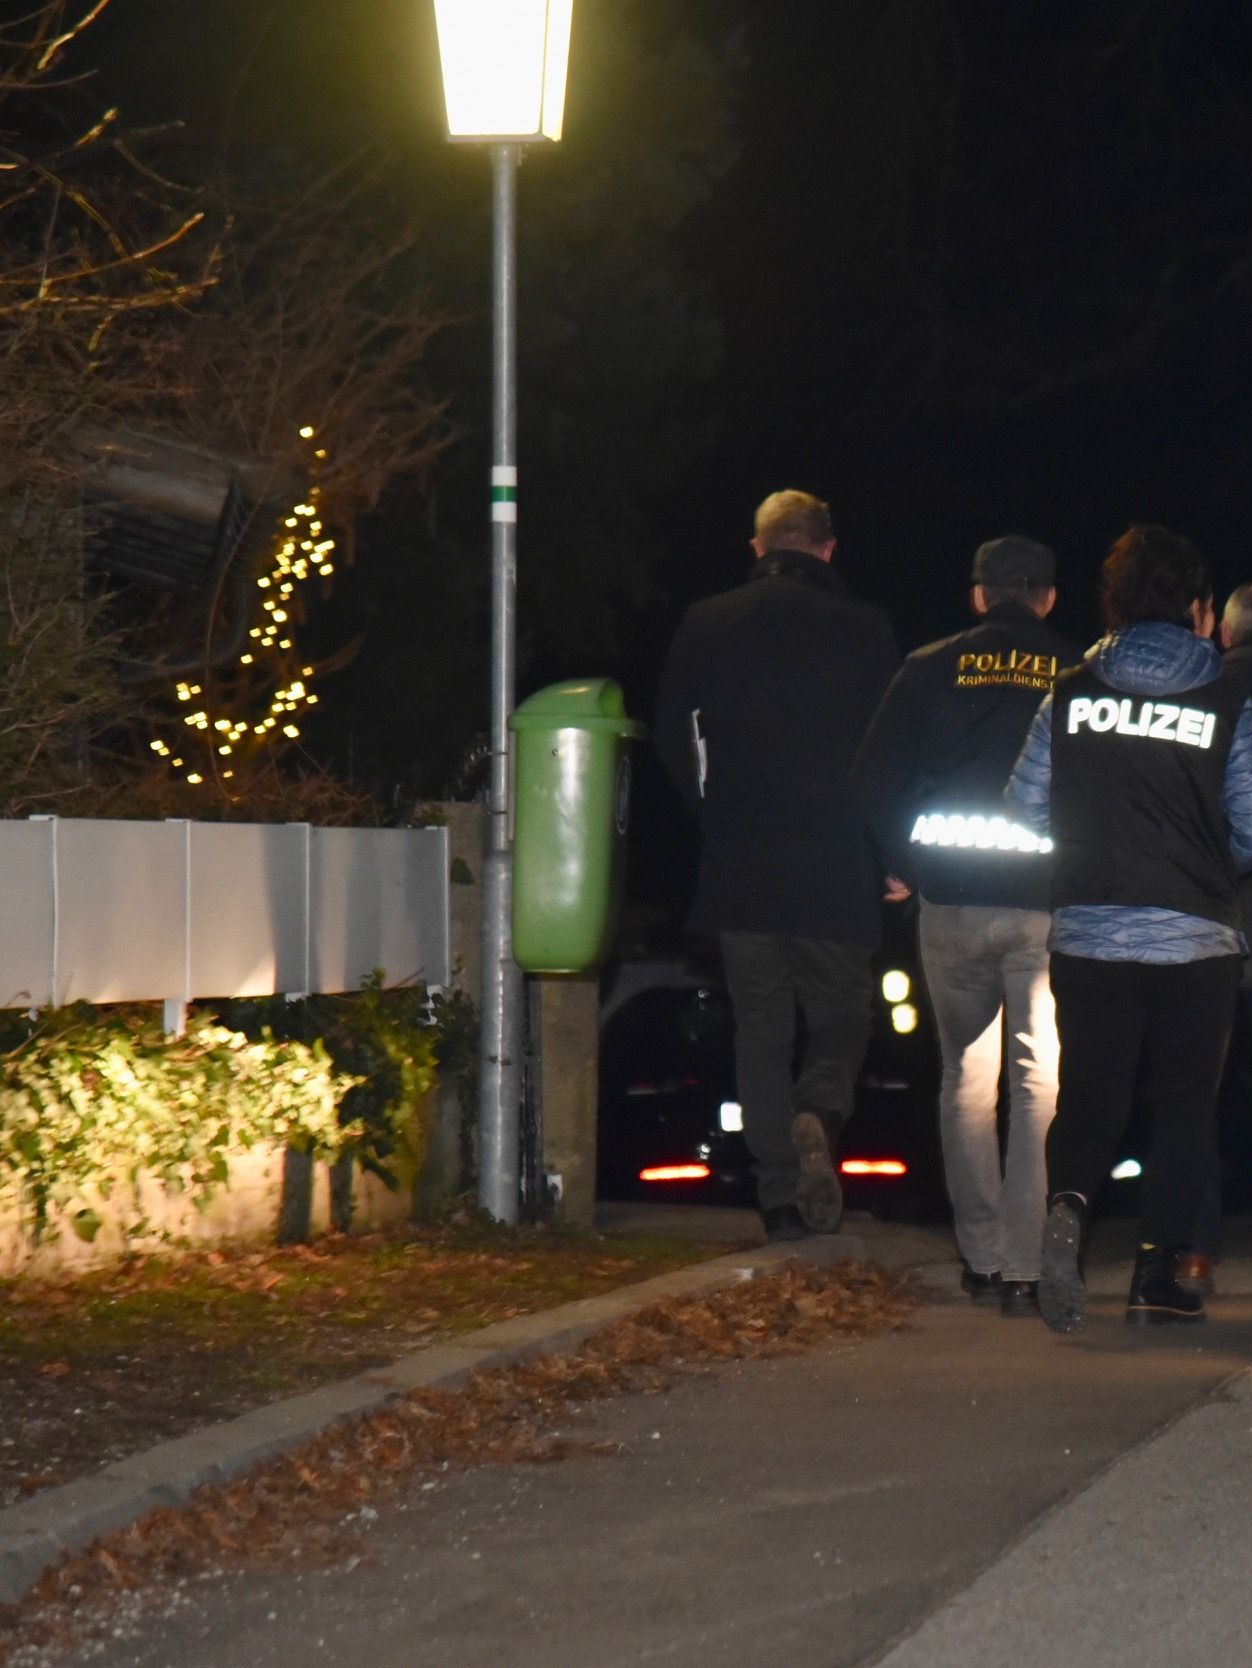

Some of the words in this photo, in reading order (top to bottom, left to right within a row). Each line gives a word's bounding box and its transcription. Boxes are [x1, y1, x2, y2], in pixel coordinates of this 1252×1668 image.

[958, 649, 1057, 676] POLIZEI
[957, 672, 1055, 693] KRIMINALDIENST
[1068, 698, 1216, 749] POLIZEI
